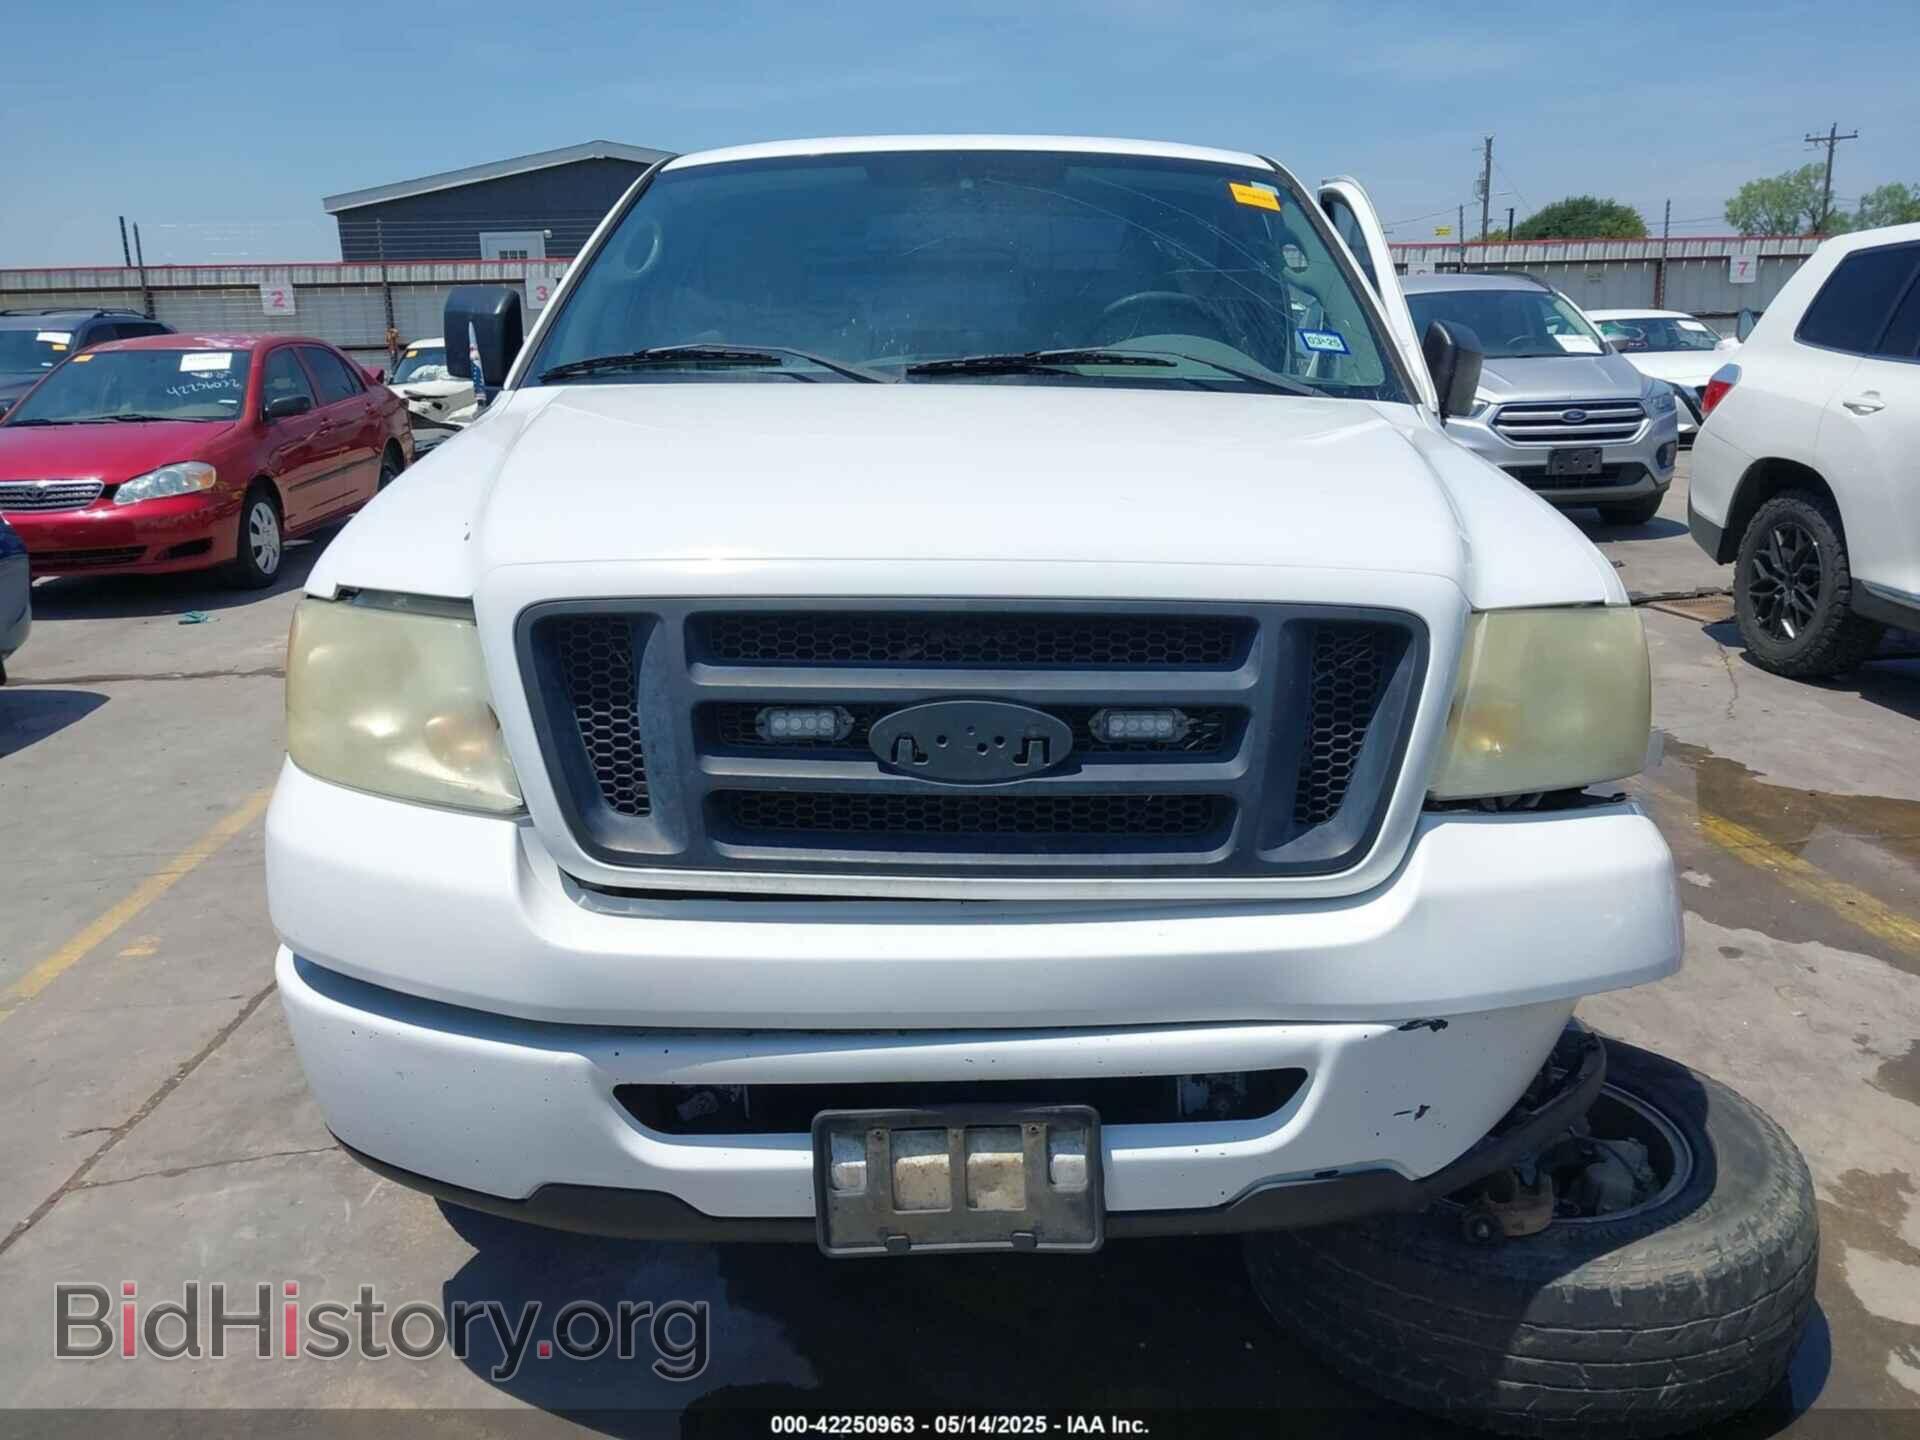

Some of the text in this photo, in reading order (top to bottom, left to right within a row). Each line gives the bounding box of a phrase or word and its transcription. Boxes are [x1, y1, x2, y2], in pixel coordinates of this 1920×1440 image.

[1738, 261, 1750, 277] 7
[271, 289, 285, 308] 2
[535, 286, 549, 301] 3
